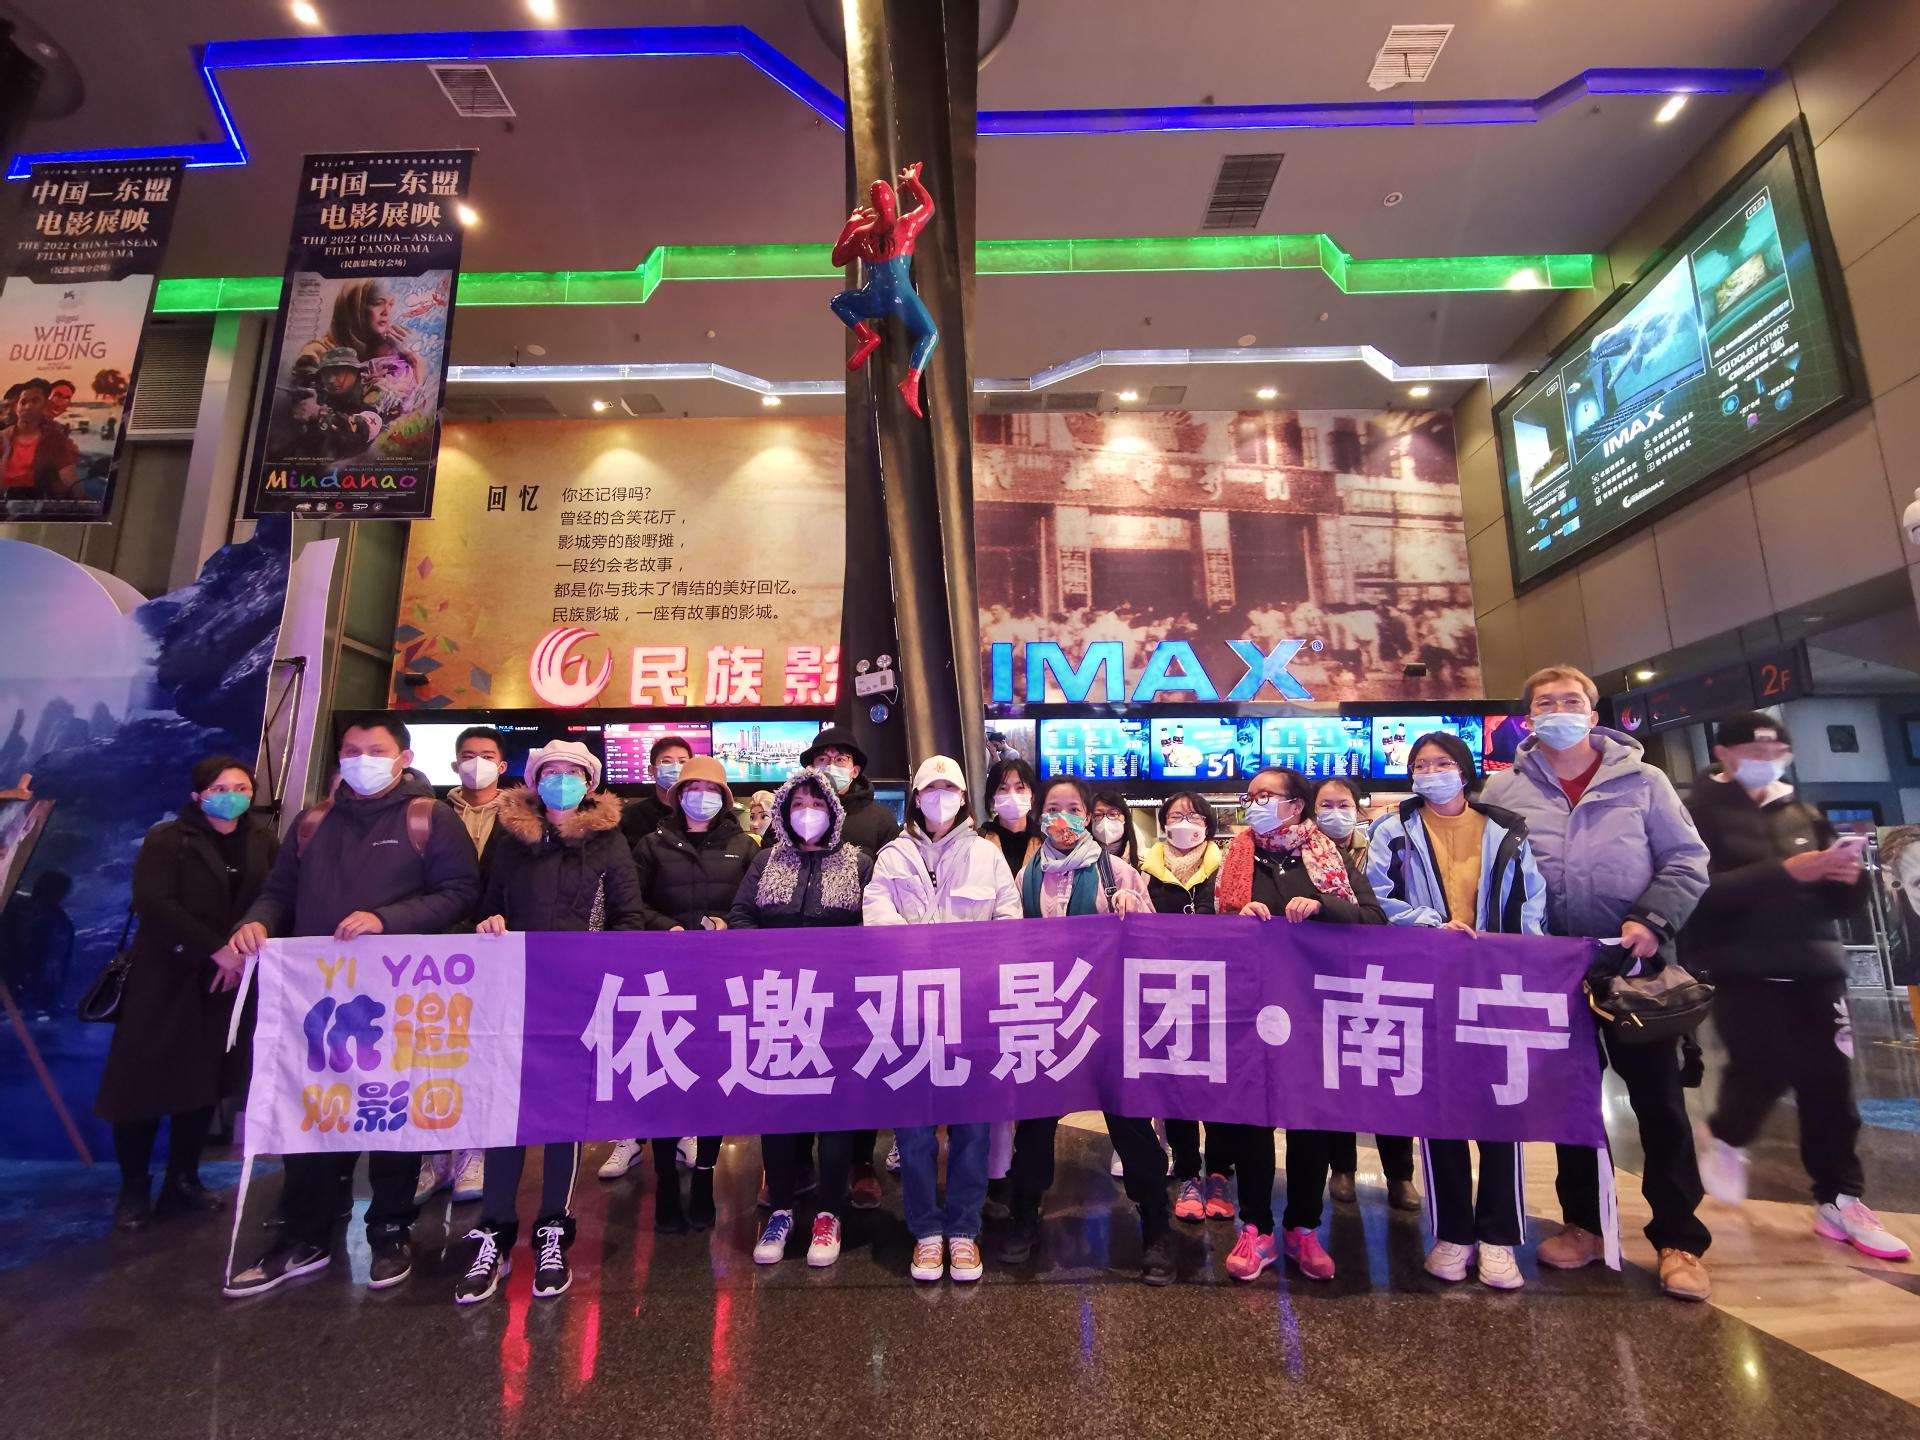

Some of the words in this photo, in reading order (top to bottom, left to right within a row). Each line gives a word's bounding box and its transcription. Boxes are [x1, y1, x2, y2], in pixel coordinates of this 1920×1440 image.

[36, 207, 151, 236] 电影展映
[320, 201, 442, 230] 电影展映
[17, 241, 40, 250] THE
[43, 241, 70, 250] 2022
[302, 235, 328, 245] THE
[331, 235, 357, 244] 2022
[324, 246, 354, 256] FILM
[359, 244, 430, 254] PANORAMA
[36, 251, 66, 261] FILM
[70, 249, 135, 260] PANORAMA
[34, 324, 96, 343] WHITE
[1730, 341, 1759, 367] DOLBY
[1759, 321, 1789, 348] ATMOS
[9, 341, 107, 361] BUILDING
[1603, 401, 1665, 458] IMAX
[265, 467, 417, 490] Mindanao
[487, 484, 540, 512] 回忆
[991, 640, 1315, 703] IMAX
[1760, 664, 1791, 696] 2F
[1123, 797, 1163, 807] oncession
[316, 957, 357, 989] YI
[382, 953, 477, 987] YAO
[302, 992, 473, 1074] 依邀
[300, 1077, 463, 1134] 观影团
